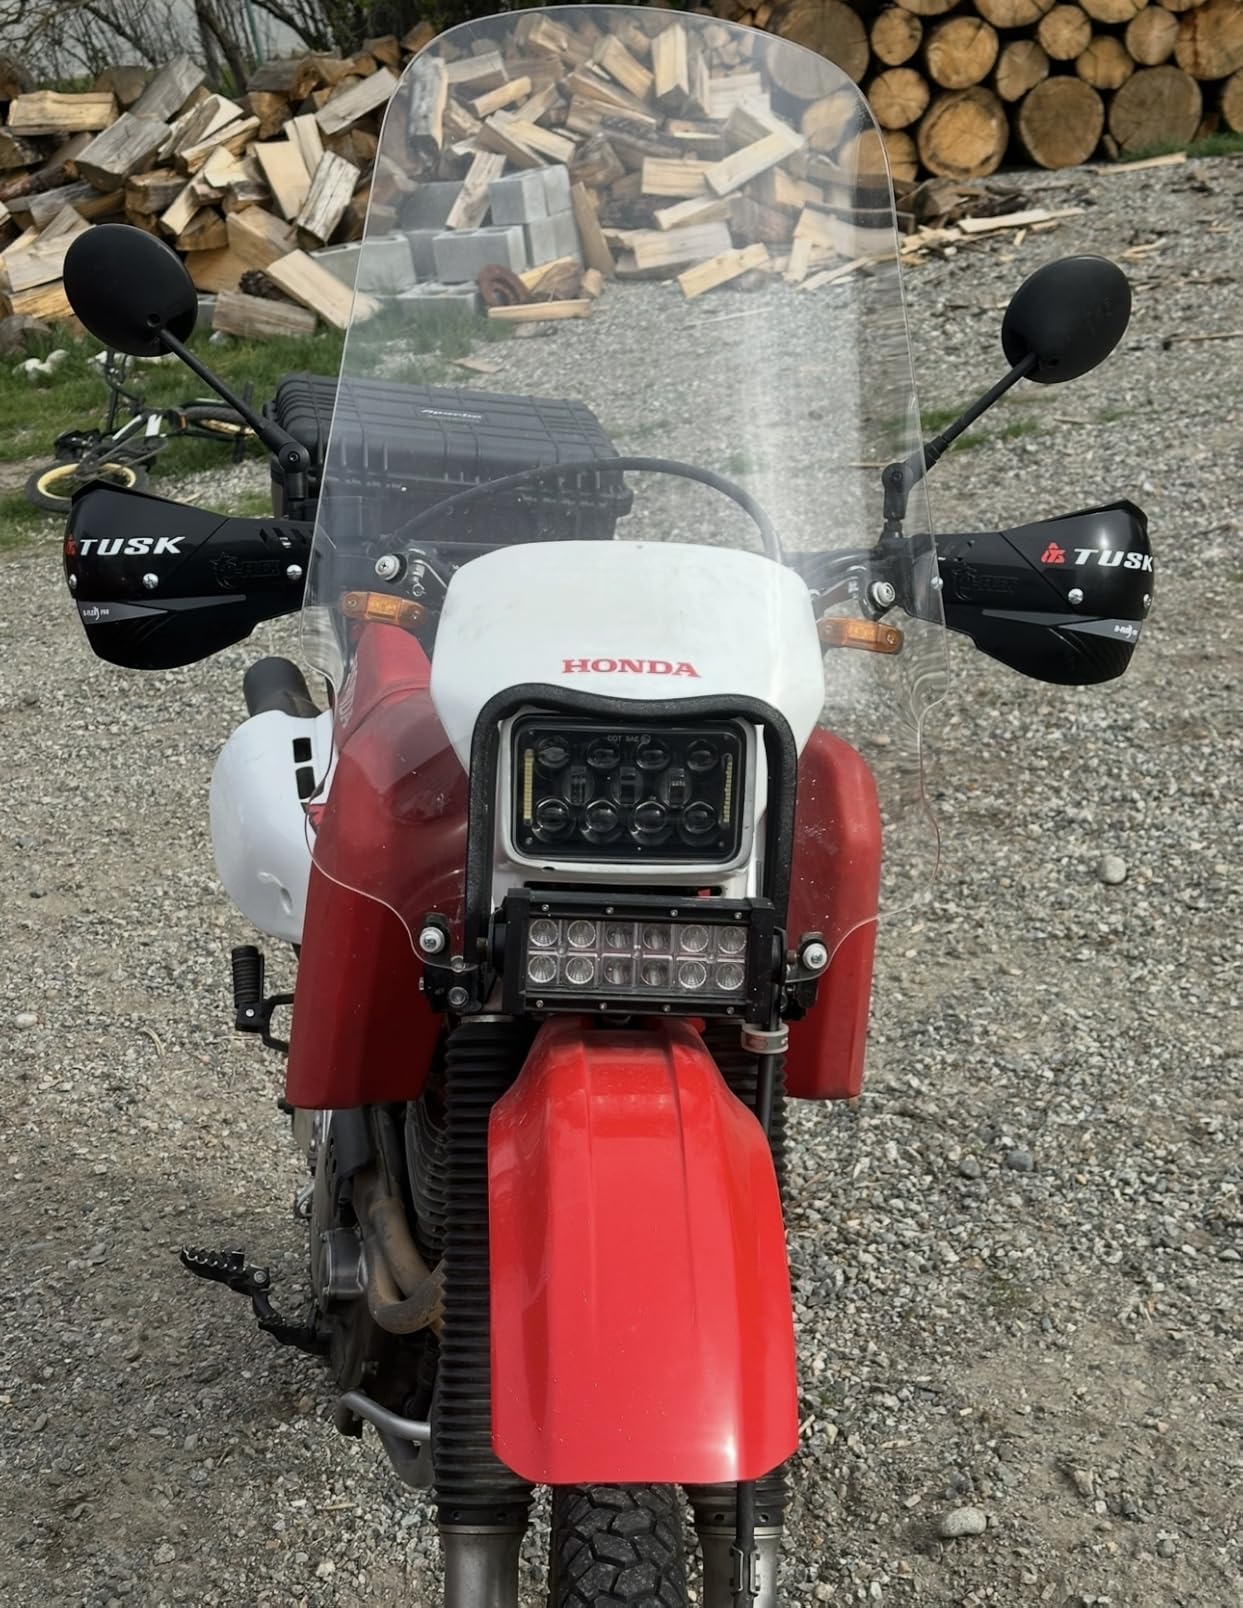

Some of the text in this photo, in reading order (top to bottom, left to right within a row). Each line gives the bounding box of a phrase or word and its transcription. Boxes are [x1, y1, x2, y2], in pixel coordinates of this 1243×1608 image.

[80, 536, 186, 556] TUSK
[1074, 548, 1153, 572] TUSK
[562, 658, 701, 678] HONDA
